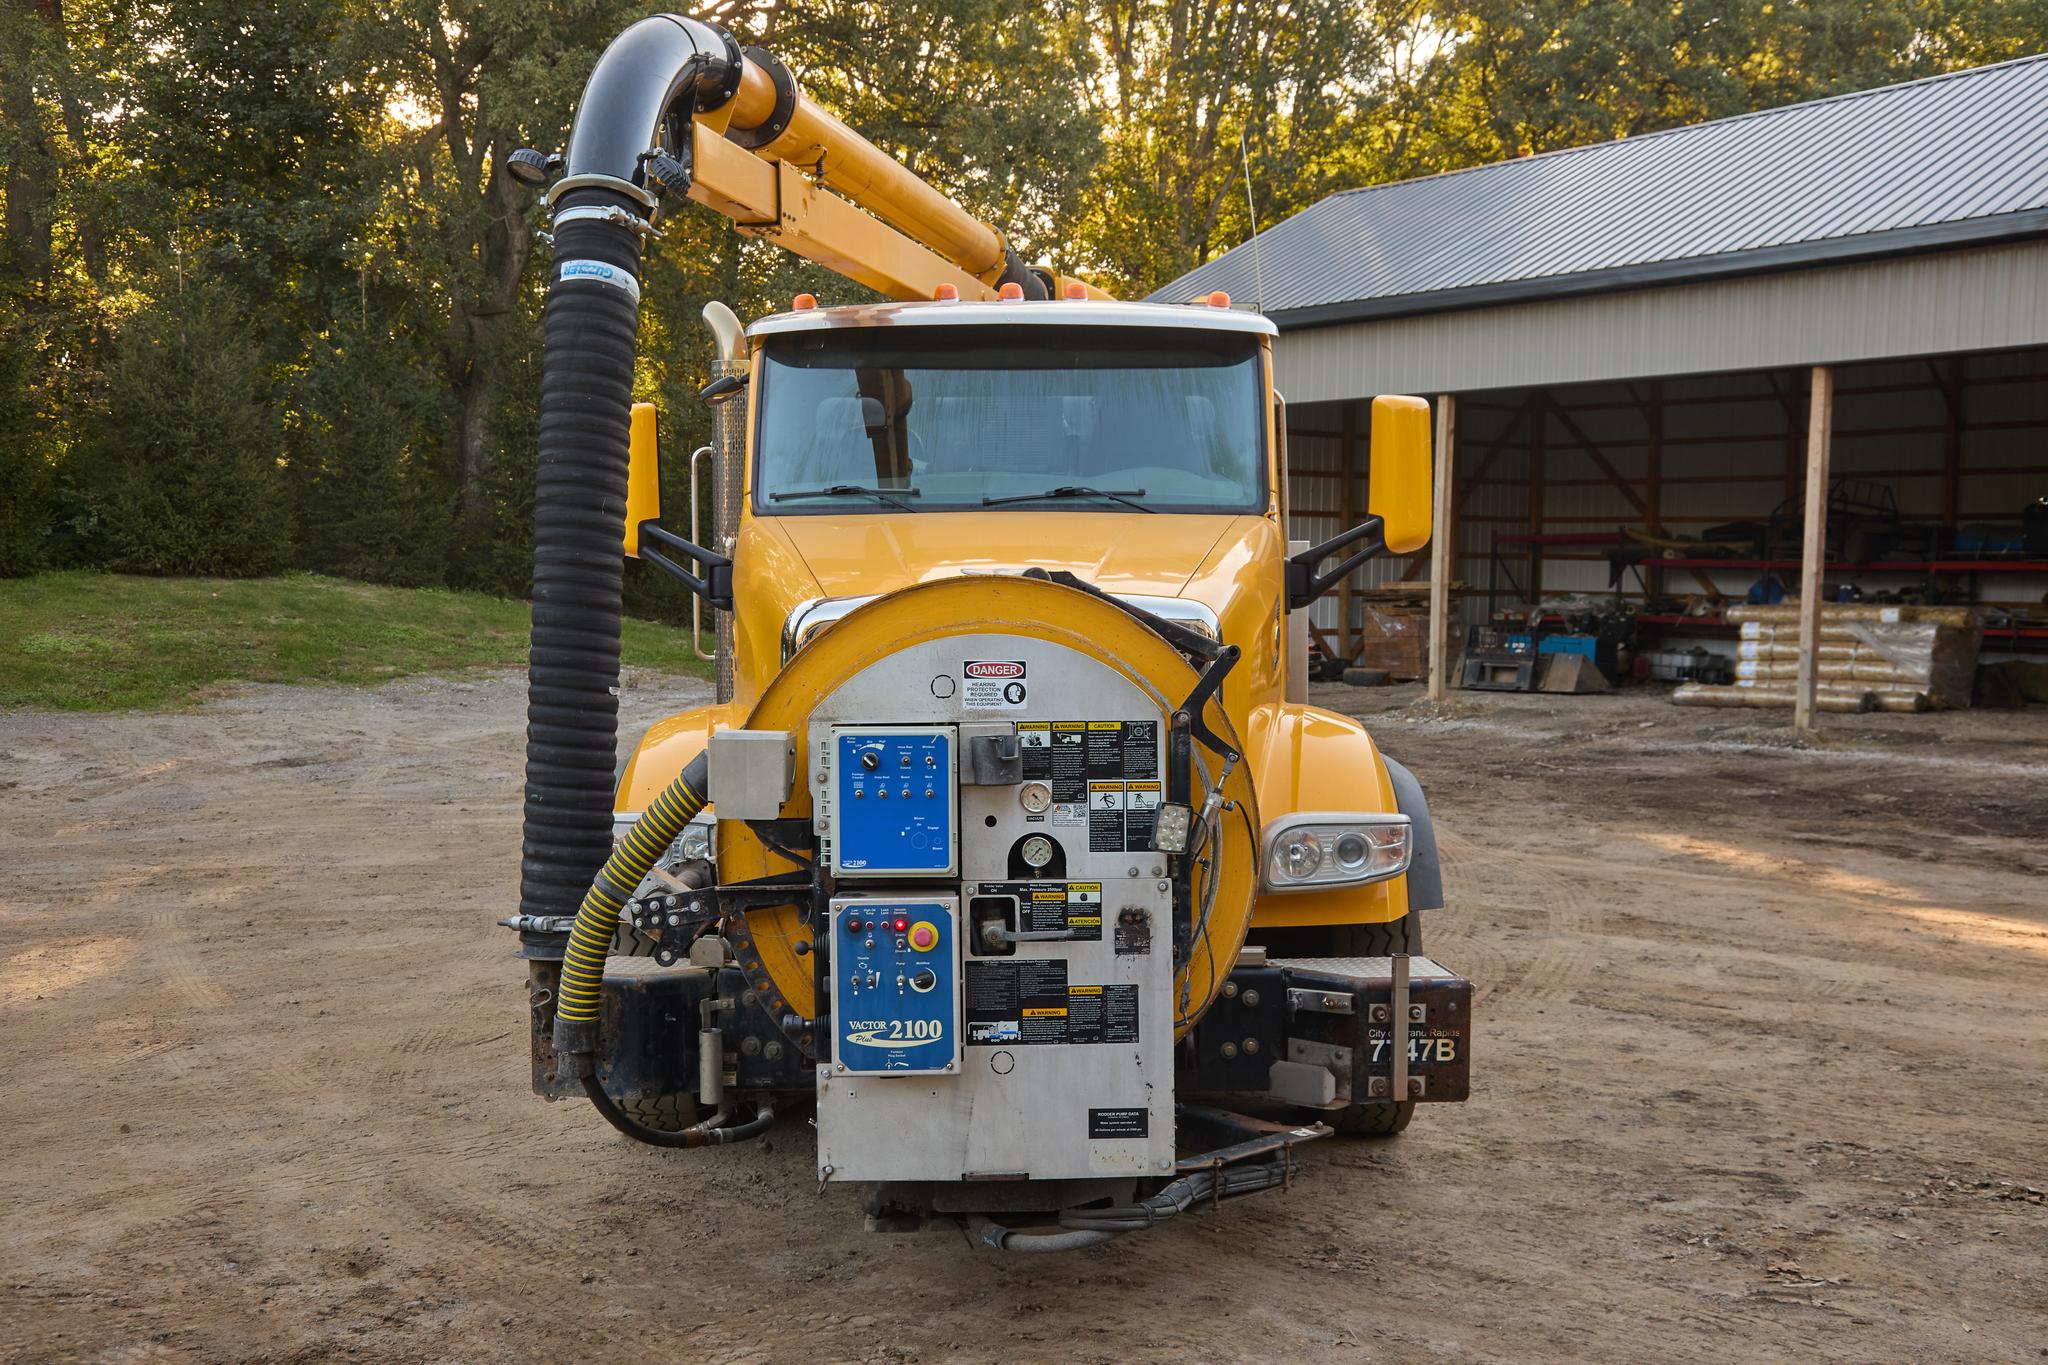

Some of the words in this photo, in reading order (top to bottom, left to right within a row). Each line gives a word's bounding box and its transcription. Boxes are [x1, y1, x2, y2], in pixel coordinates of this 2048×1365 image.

[973, 665, 1018, 675] DANGER
[849, 1020, 887, 1030] VACTOR
[889, 1019, 943, 1039] 2100
[1368, 1028, 1387, 1039] City
[855, 1034, 873, 1043] Plus
[1370, 1039, 1455, 1062] 747B
